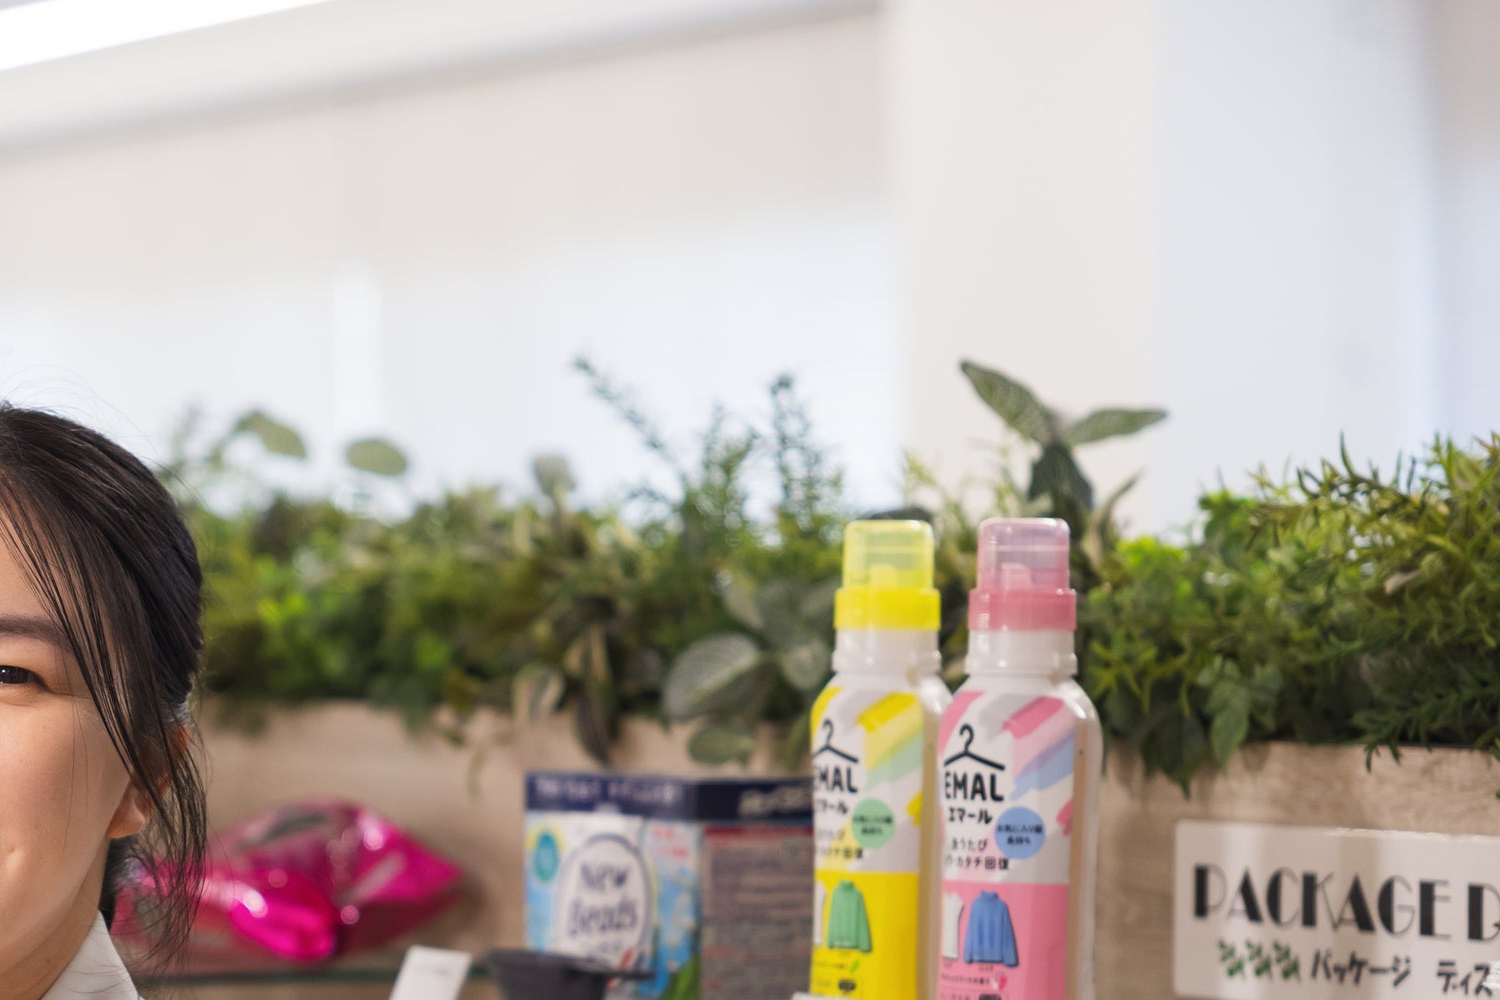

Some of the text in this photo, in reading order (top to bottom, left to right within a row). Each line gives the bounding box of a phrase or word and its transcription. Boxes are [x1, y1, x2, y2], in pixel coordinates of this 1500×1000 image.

[813, 766, 858, 794] MAL
[945, 772, 1004, 802] EMAL
[949, 807, 993, 824] エマール
[1194, 864, 1452, 940] PACKAGE
[1310, 949, 1412, 988] パッケージ
